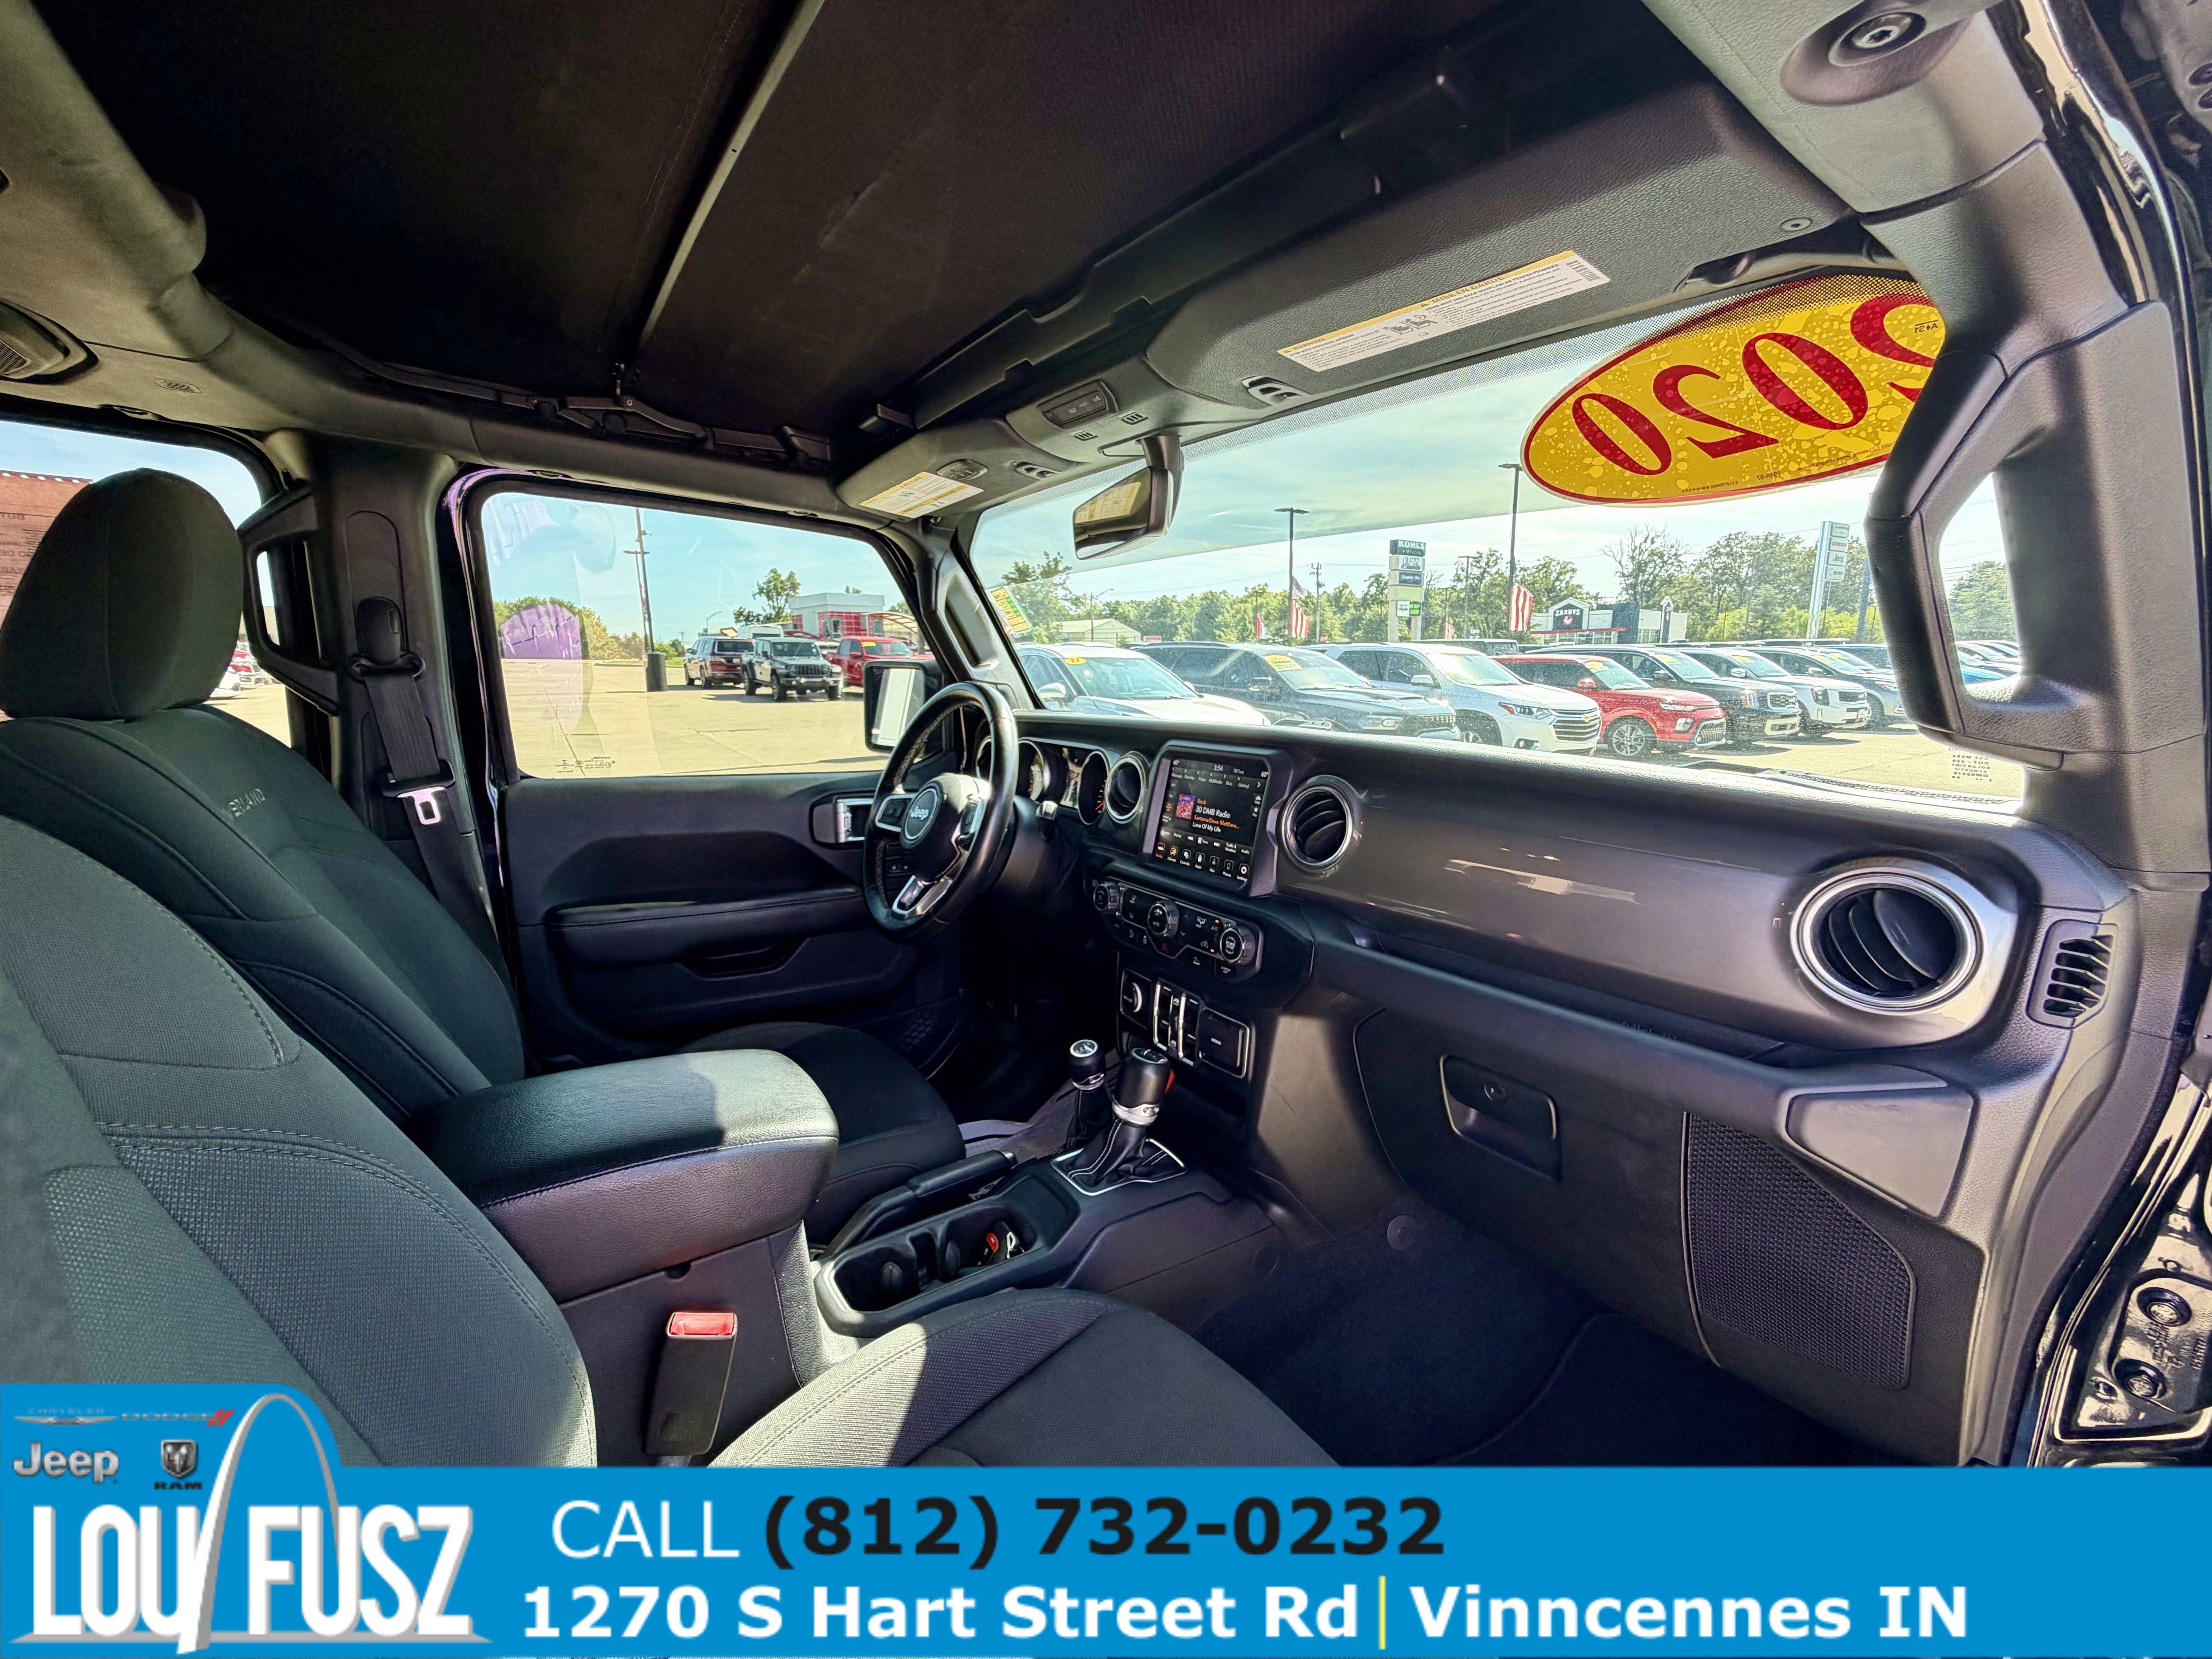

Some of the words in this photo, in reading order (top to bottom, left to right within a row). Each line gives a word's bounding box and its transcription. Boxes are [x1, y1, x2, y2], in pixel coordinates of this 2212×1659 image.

[1432, 292, 1455, 303] MISE
[1471, 276, 1505, 290] GARDE
[1292, 337, 1326, 350] WARNING
[910, 805, 929, 821] Jeep
[1202, 807, 1215, 816] DMB
[1215, 809, 1231, 819] Radio
